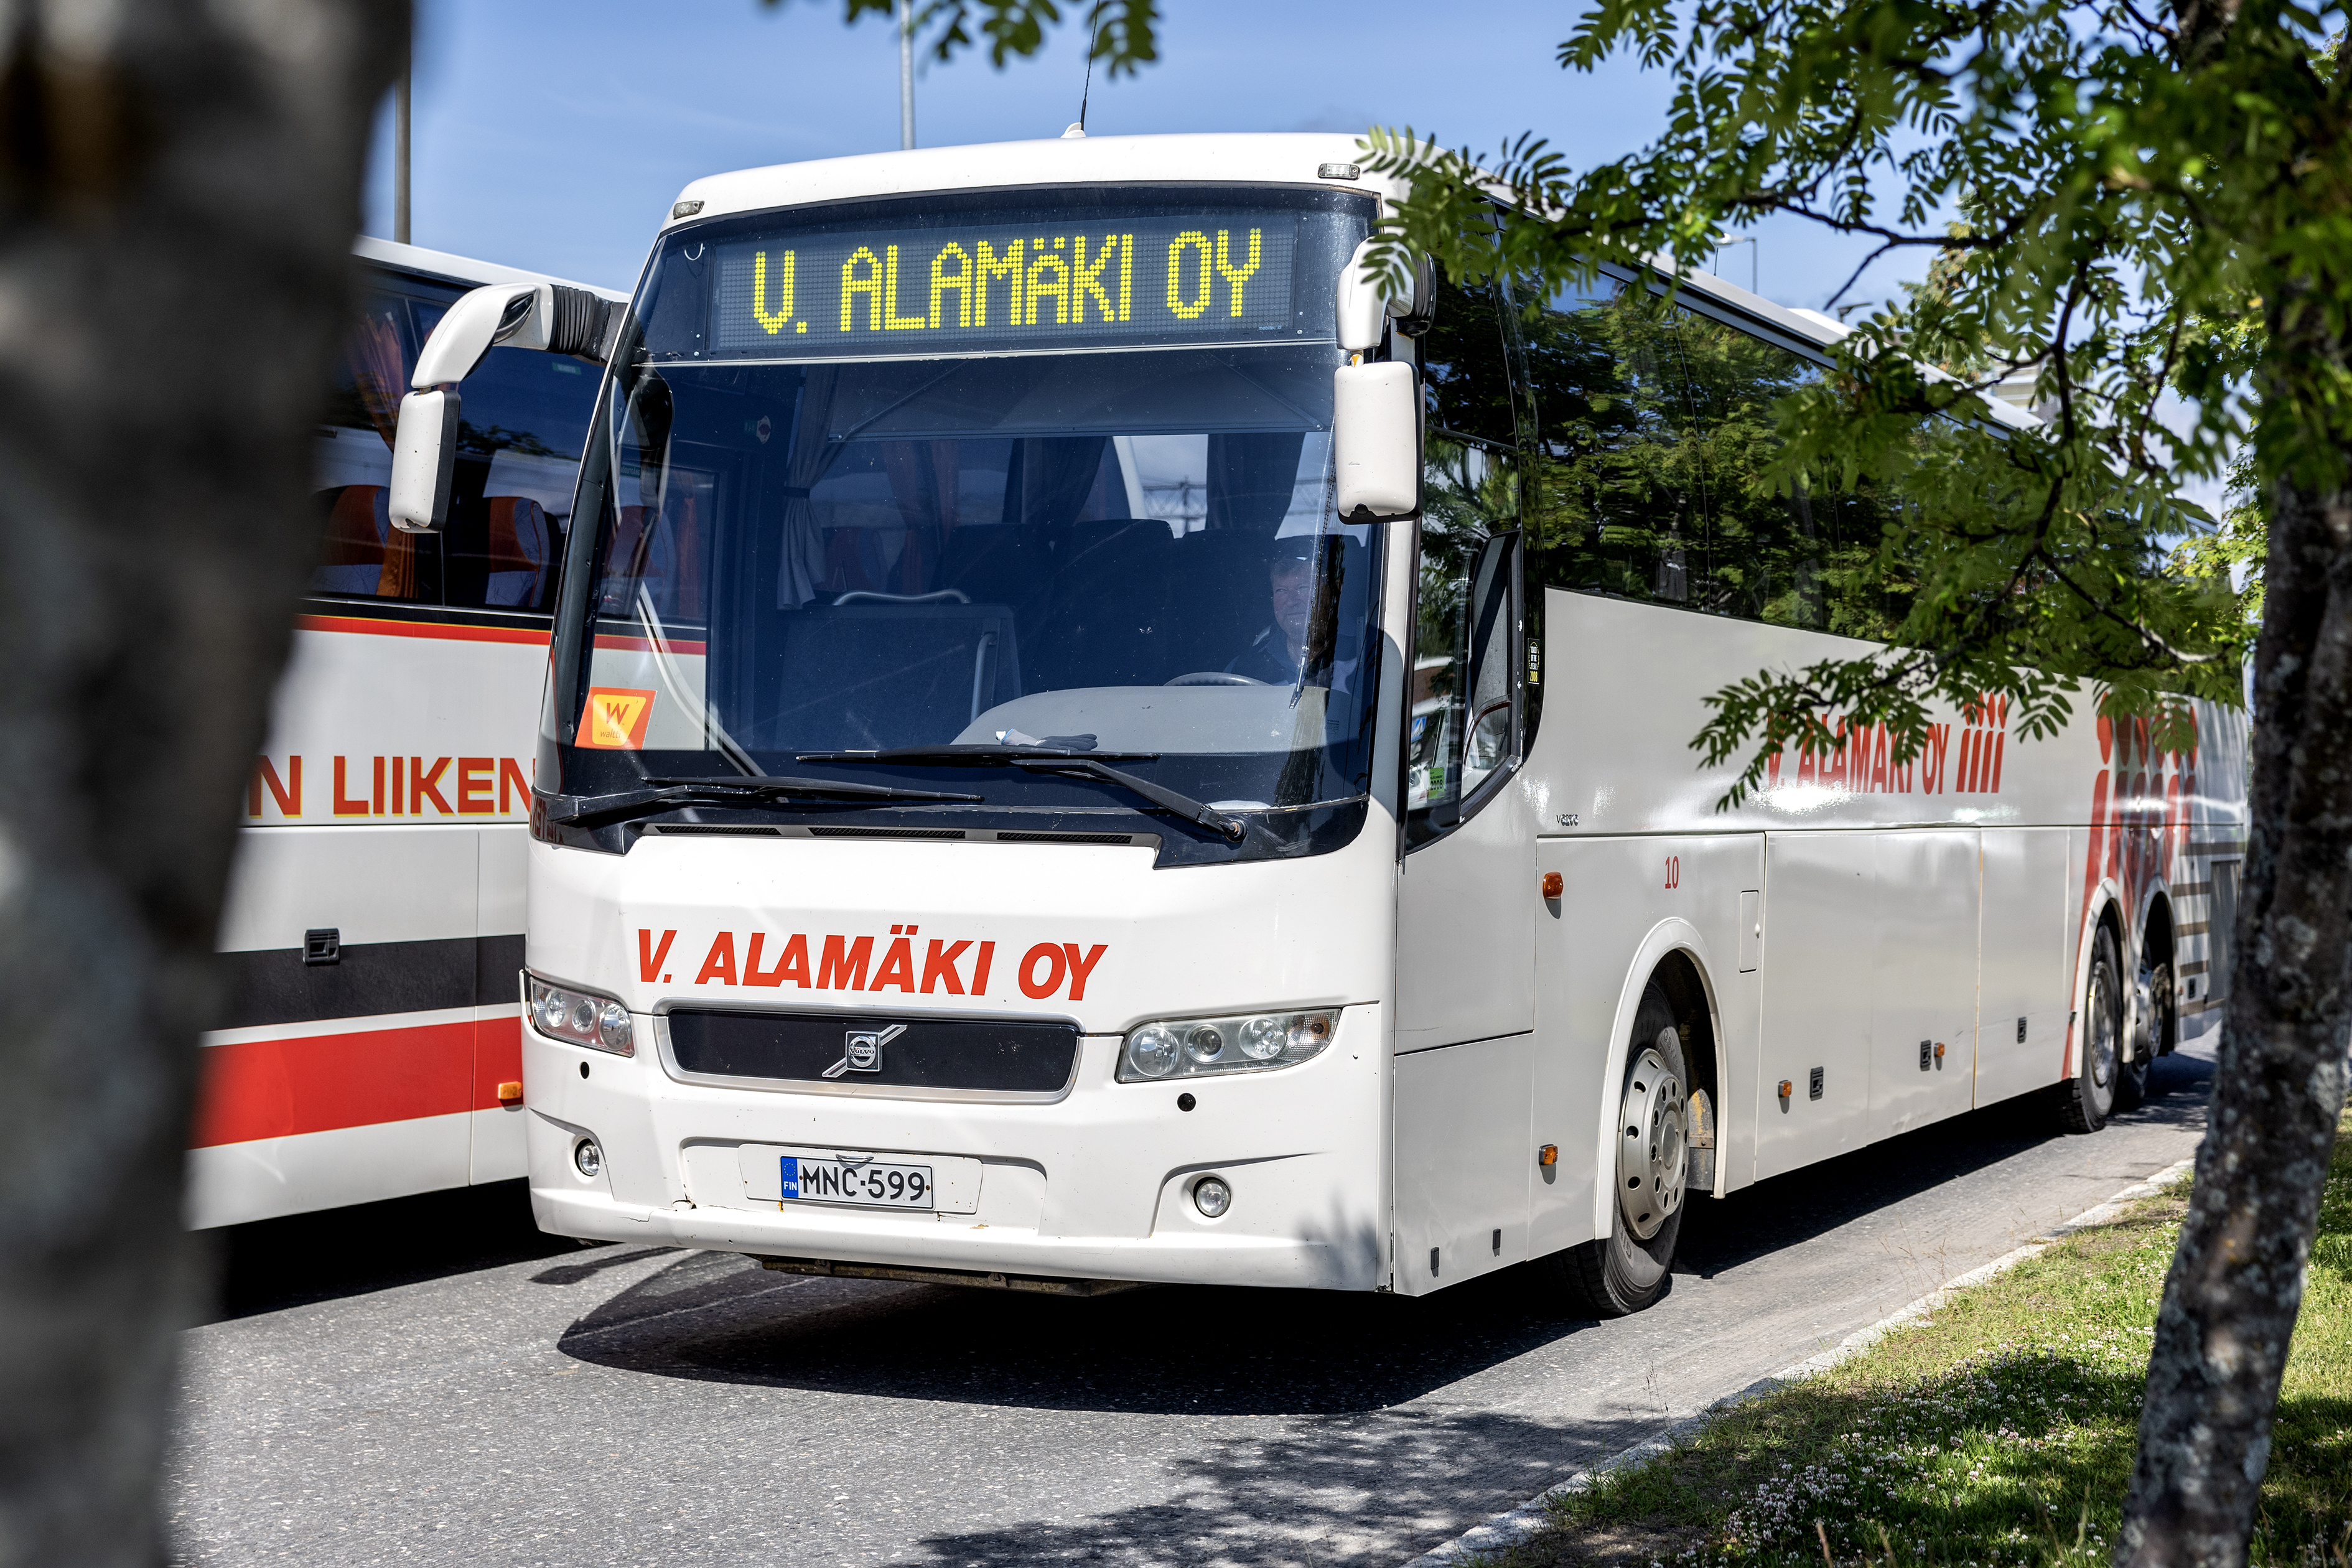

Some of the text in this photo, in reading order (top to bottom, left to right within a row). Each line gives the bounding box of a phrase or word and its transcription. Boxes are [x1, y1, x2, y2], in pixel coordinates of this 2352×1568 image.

[754, 228, 1261, 334] V. ALAMÄKI OY
[600, 728, 621, 739] waltti
[1923, 722, 1950, 795] OY
[1430, 779, 1443, 790] 2008
[1665, 856, 1679, 889] 10
[638, 925, 1108, 1001] V. ALAMÄKI OY
[783, 1164, 925, 1202] FIN MNC-599
